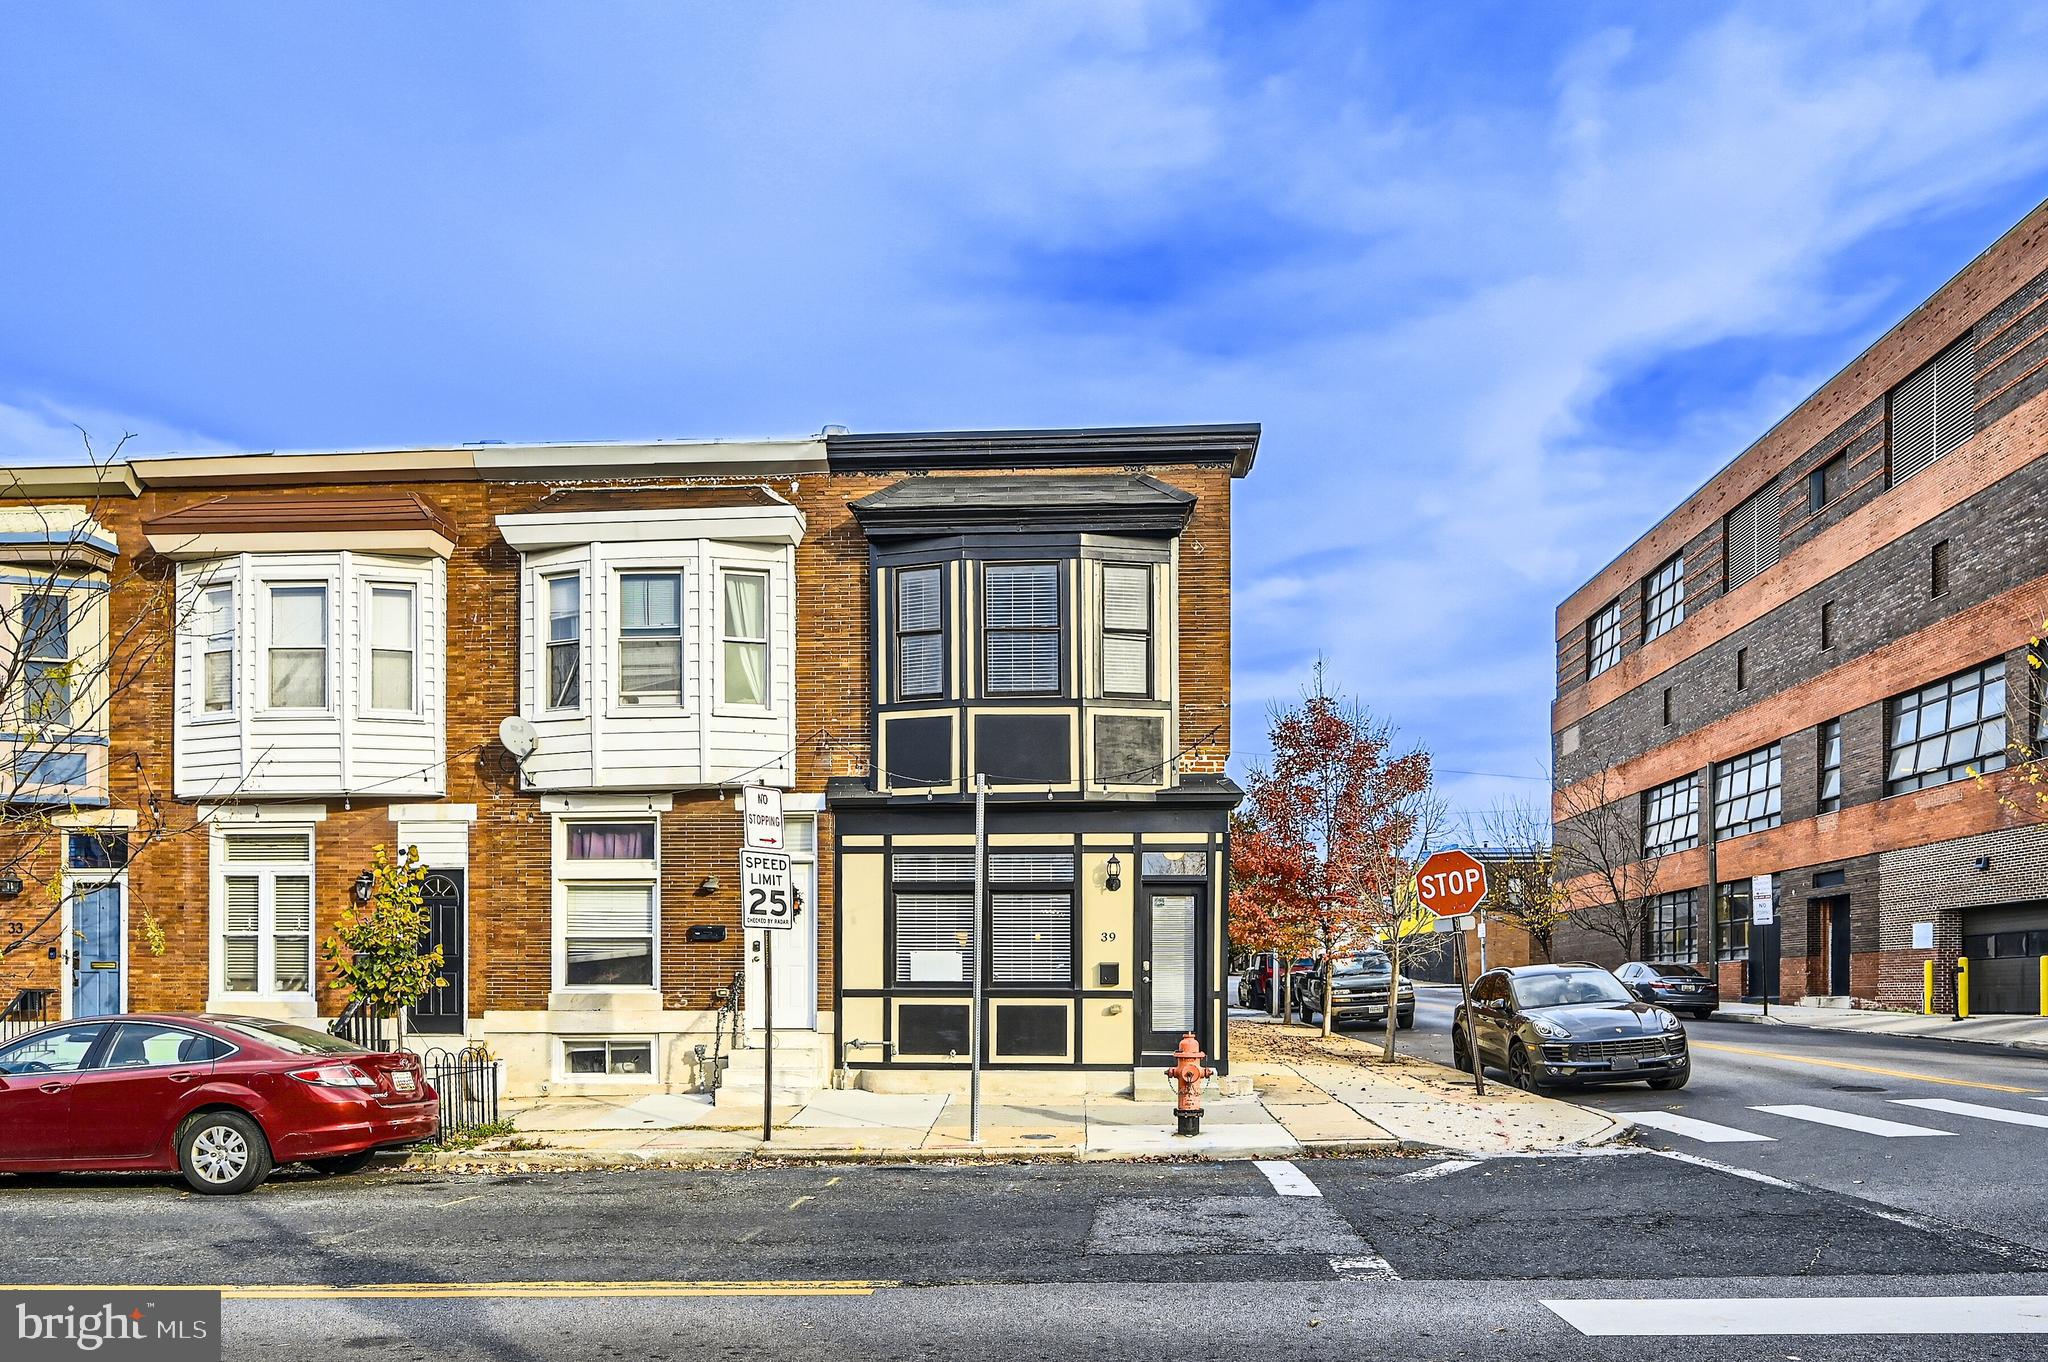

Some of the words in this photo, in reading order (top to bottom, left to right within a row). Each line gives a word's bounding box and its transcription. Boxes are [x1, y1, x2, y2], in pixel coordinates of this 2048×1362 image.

[757, 793, 768, 805] NO
[748, 813, 780, 827] STOPPING
[745, 856, 787, 871] SPEED
[750, 873, 783, 886] LIMIT
[1421, 868, 1480, 899] STOP
[749, 888, 787, 917] 25
[8, 922, 24, 934] 33
[1100, 931, 1116, 943] 39
